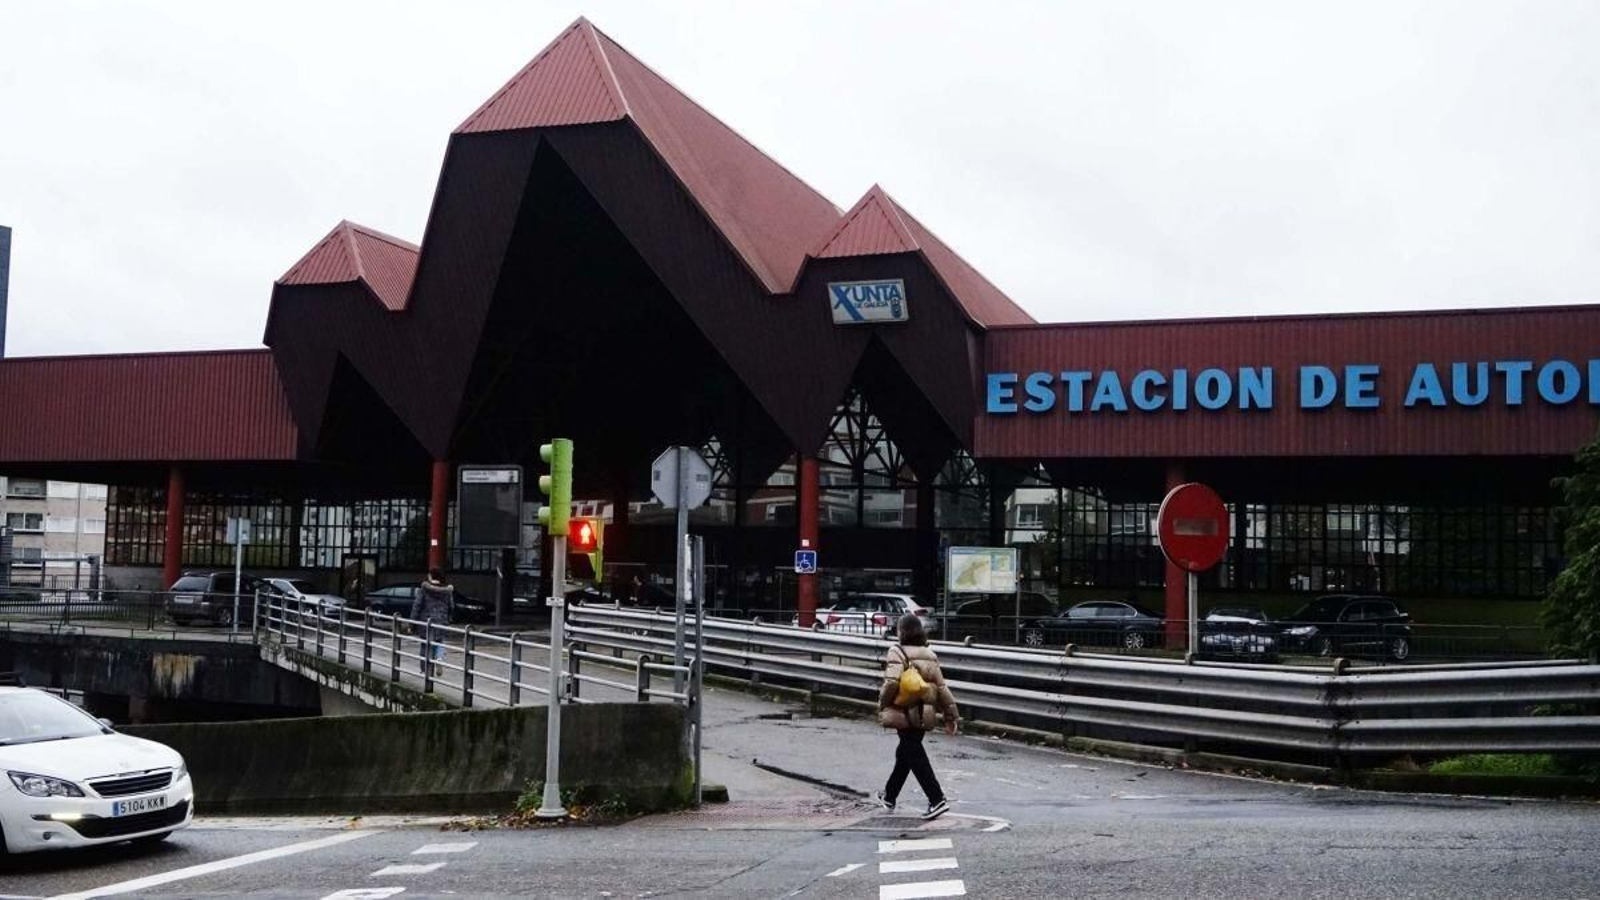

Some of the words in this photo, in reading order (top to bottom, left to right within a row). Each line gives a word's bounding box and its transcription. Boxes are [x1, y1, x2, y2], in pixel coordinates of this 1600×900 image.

[832, 284, 902, 320] XUNTA
[986, 367, 1273, 413] ESTACION
[1300, 364, 1380, 408] DE
[120, 799, 145, 814] 5104
